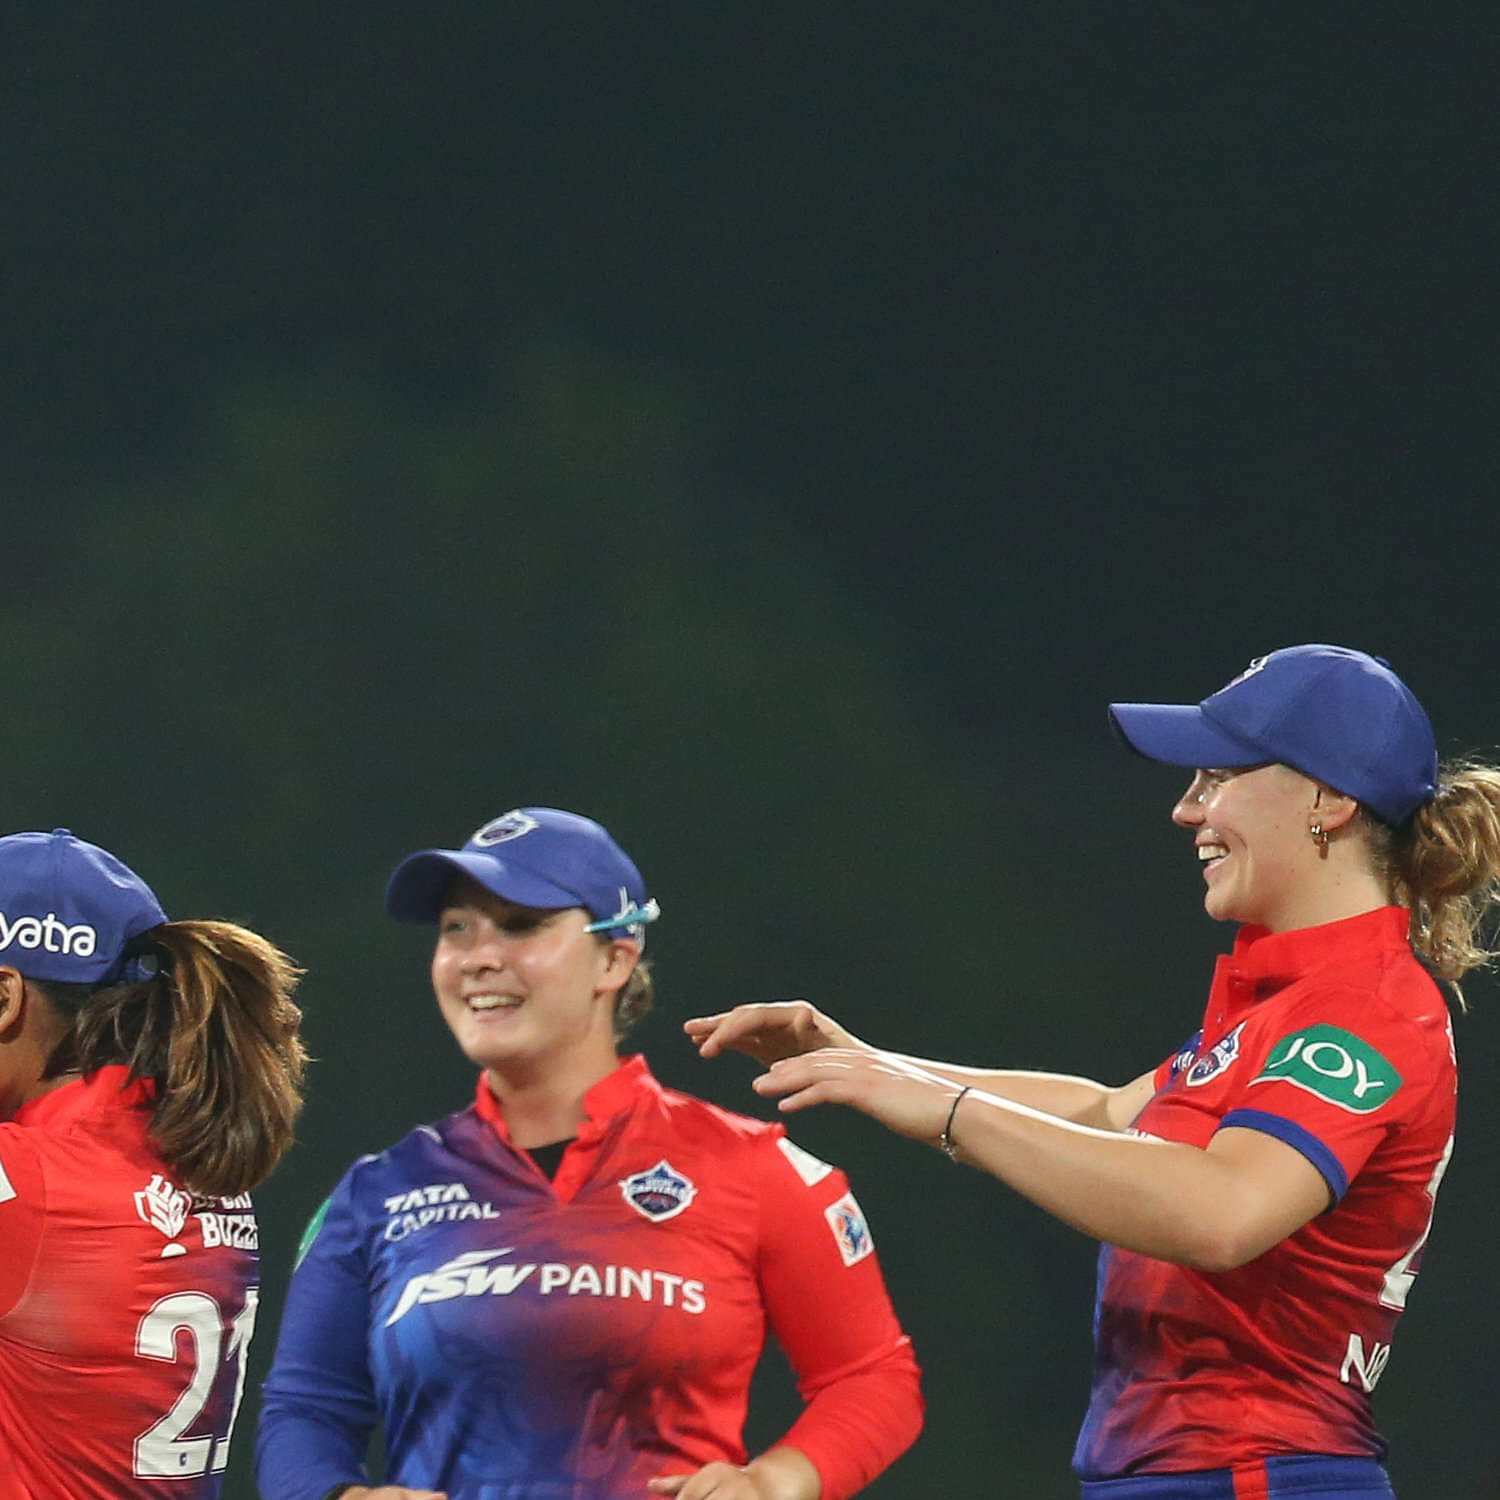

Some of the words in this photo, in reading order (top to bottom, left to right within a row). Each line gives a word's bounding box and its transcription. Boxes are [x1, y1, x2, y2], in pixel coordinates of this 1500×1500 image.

[1268, 1037, 1385, 1099] JOY
[384, 1183, 471, 1215] TATA
[384, 1201, 500, 1241] CAPITAL
[540, 1262, 707, 1315] PAINTS
